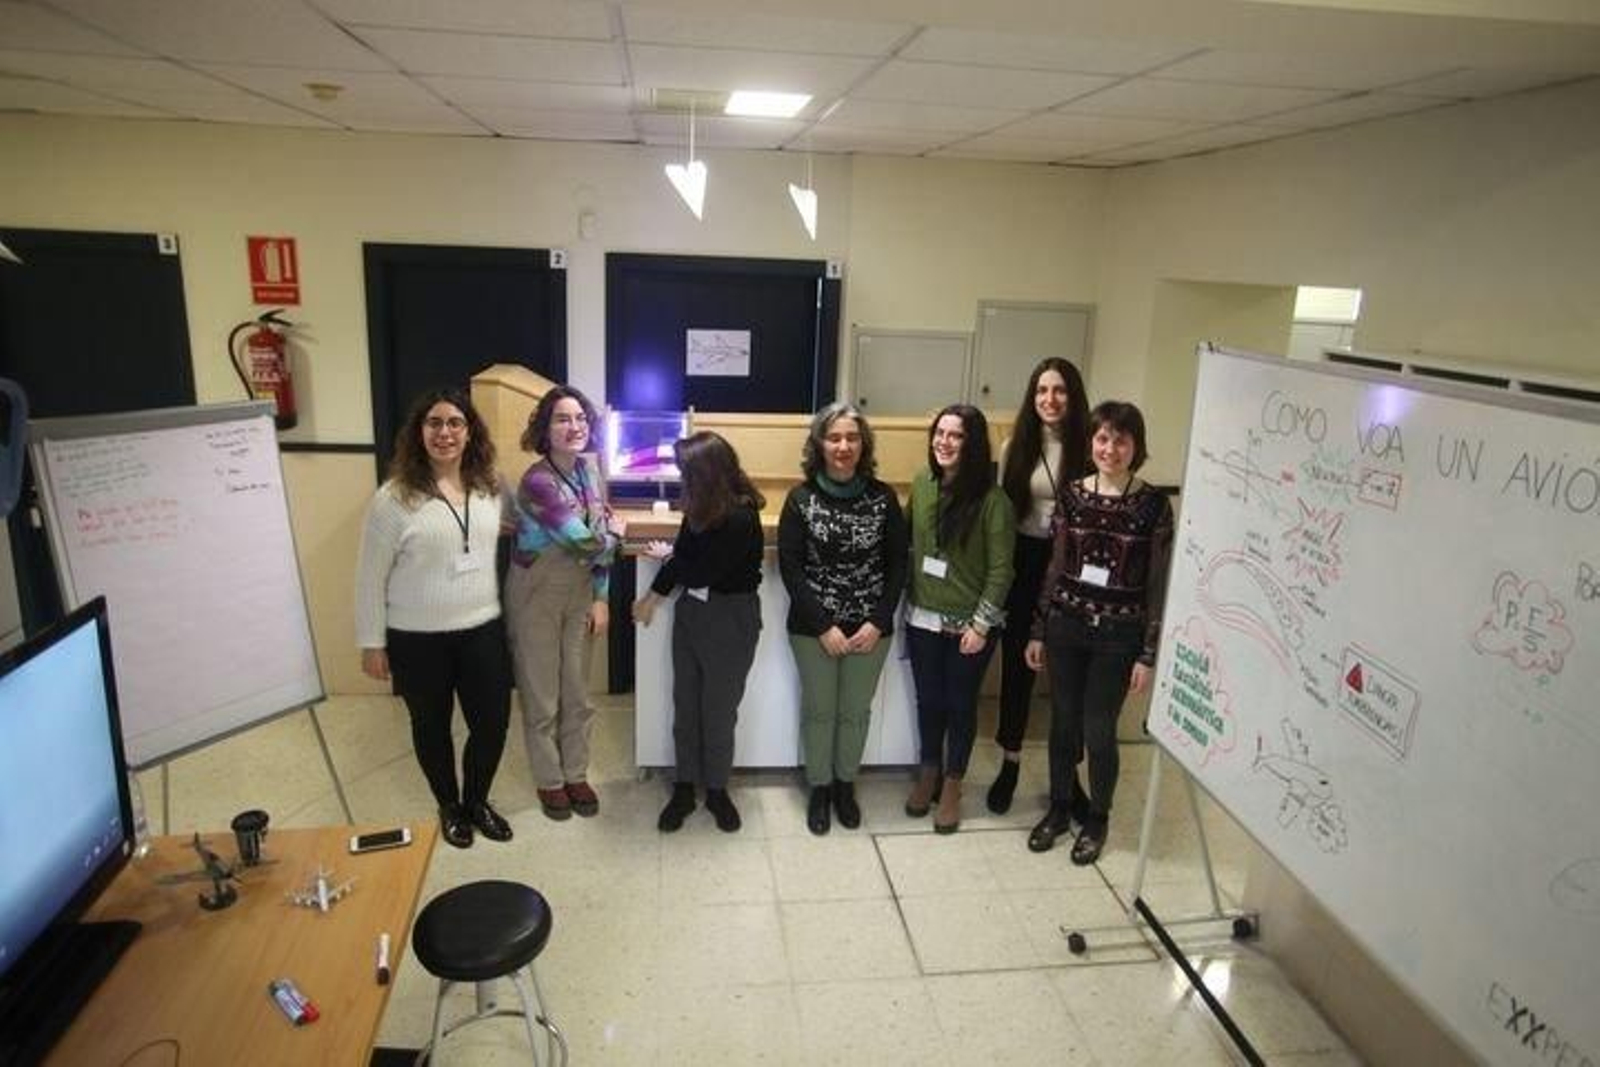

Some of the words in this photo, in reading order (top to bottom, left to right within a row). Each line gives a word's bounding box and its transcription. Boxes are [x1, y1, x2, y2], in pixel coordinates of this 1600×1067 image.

[1261, 390, 1327, 443] COMO
[1356, 421, 1405, 462] VOA
[1437, 434, 1485, 481] UN
